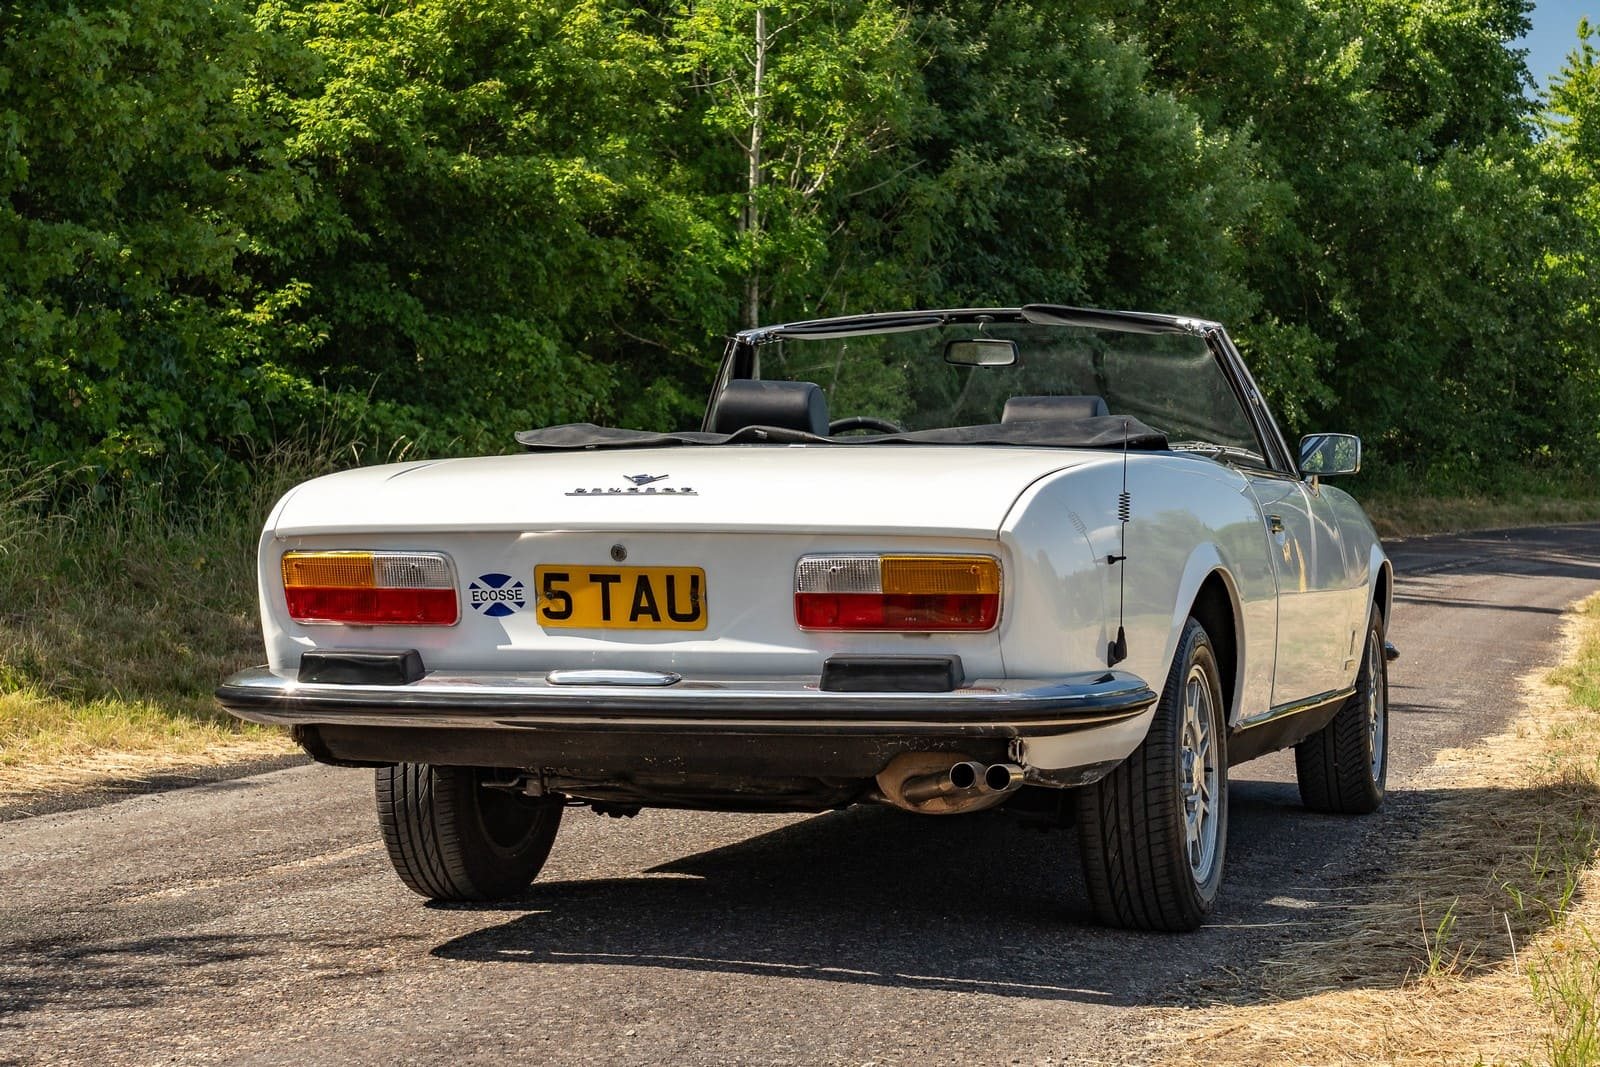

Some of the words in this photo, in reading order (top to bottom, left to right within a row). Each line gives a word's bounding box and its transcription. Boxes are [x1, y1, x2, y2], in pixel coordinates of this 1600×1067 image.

[472, 589, 523, 602] ECOSSE
[542, 572, 573, 620] 5
[589, 573, 701, 622] TAU
